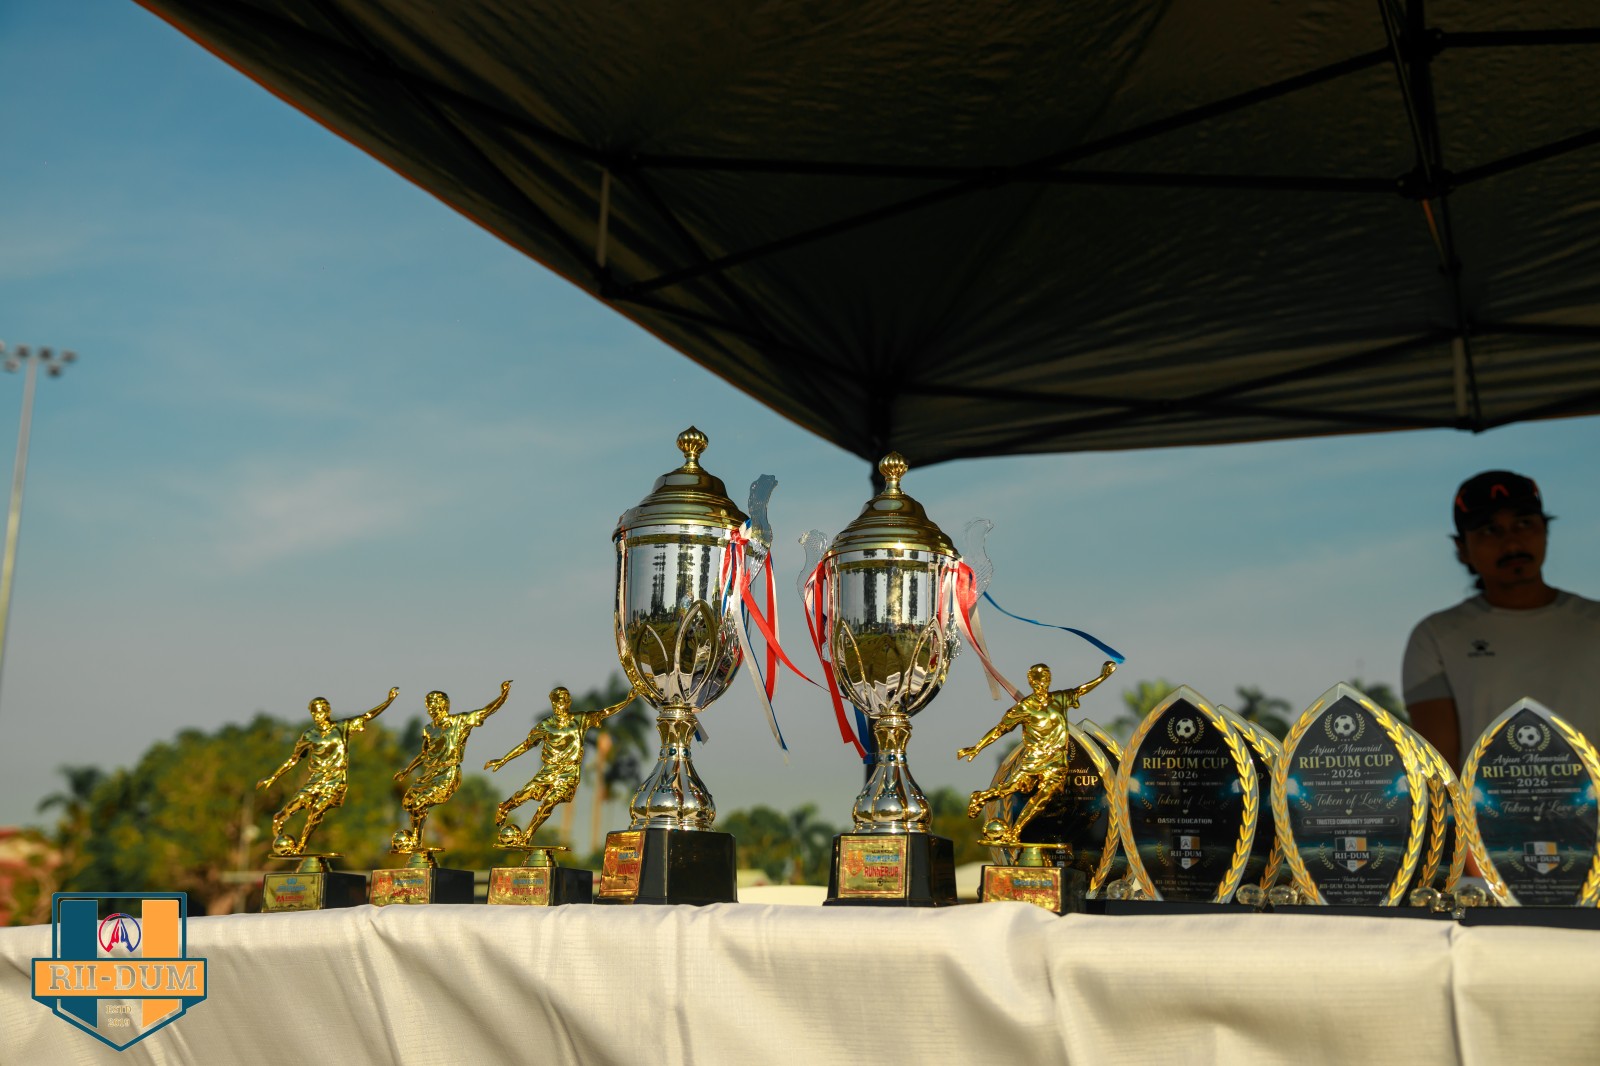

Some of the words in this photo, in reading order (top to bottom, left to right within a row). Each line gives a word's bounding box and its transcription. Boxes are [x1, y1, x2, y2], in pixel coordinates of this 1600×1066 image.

[1310, 744, 1336, 756] Arjun
[1338, 743, 1382, 754] Memorial
[1142, 757, 1198, 769] RII-DUM
[1202, 757, 1229, 769] CUP
[1299, 756, 1360, 769] RII-DUM
[1364, 754, 1394, 767] CUP
[1171, 770, 1198, 779] 2026
[1331, 769, 1361, 778] 2026
[1482, 765, 1548, 778] RII-DUM
[1551, 763, 1582, 776] CUP
[1074, 775, 1098, 786] CUP
[1517, 778, 1548, 787] 2026
[1315, 793, 1344, 807] Token
[1346, 795, 1357, 809] of
[1360, 792, 1383, 809] Love
[1533, 802, 1545, 816] of
[1335, 852, 1369, 860] RII-DUM
[864, 866, 899, 878] RUNNER-UP
